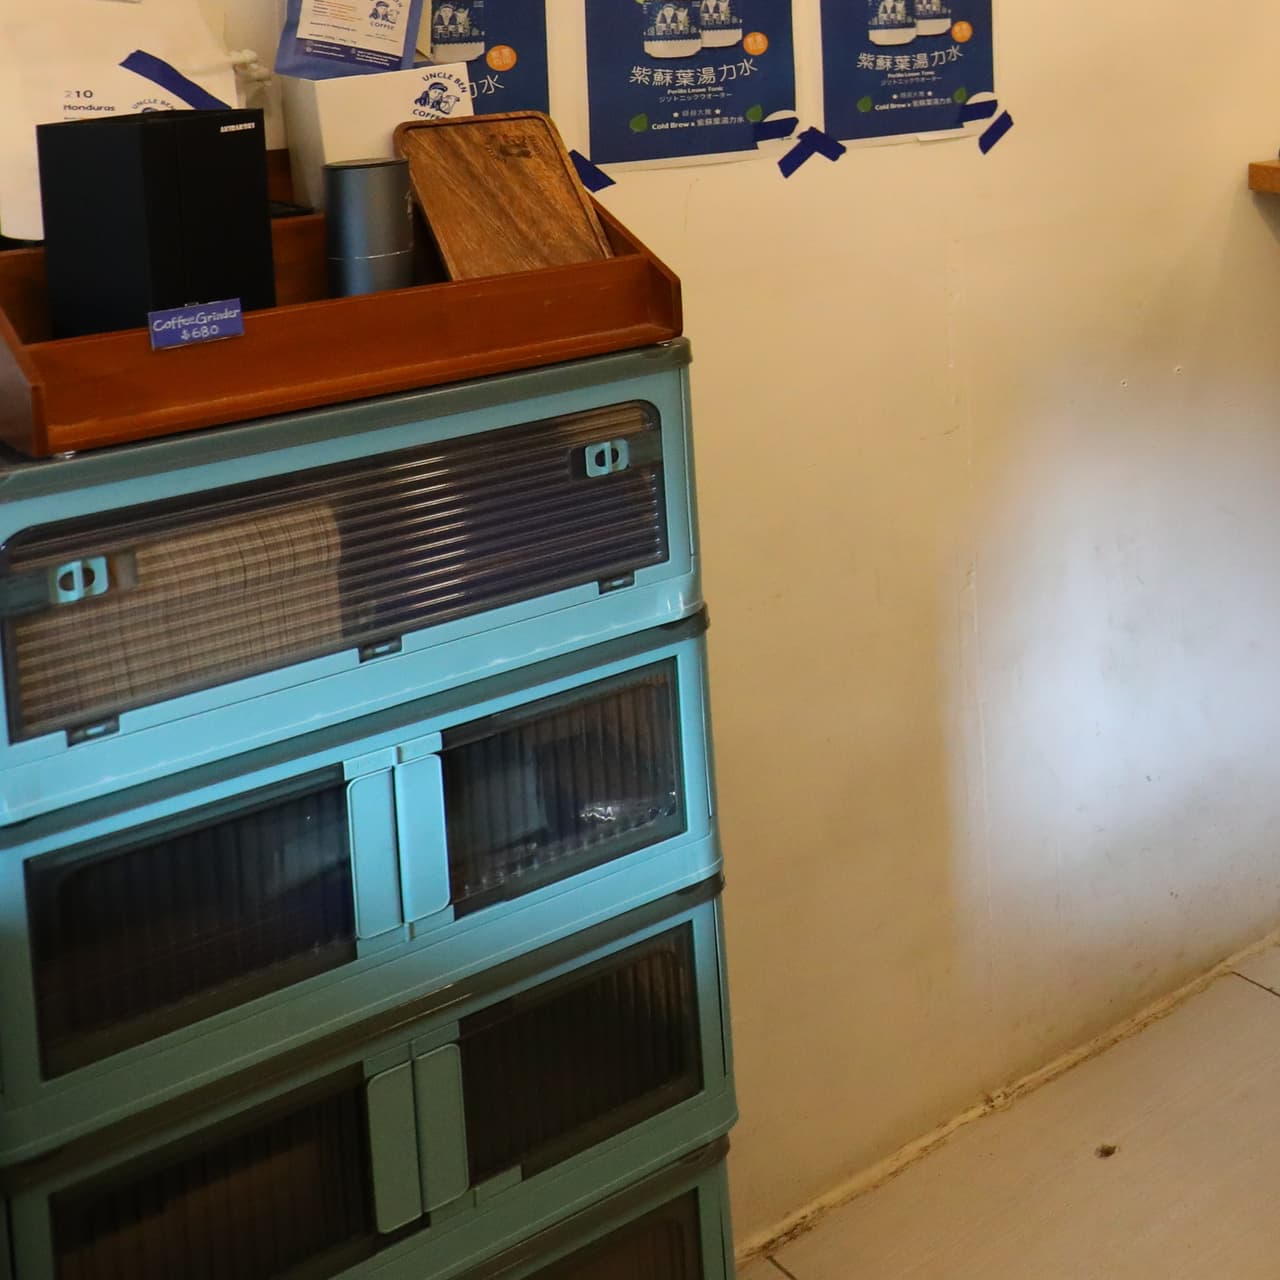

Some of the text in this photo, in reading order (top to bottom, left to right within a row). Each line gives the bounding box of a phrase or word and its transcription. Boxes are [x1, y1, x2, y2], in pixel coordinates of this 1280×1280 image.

[857, 45, 964, 71] 紫蘇葉湯力水
[421, 71, 468, 94] UNCLE BEN
[629, 58, 759, 87] 紫蘇葉湯力水
[63, 103, 116, 112] Honduras
[152, 307, 241, 332] Coffee Grinder
[180, 324, 220, 341] $680
